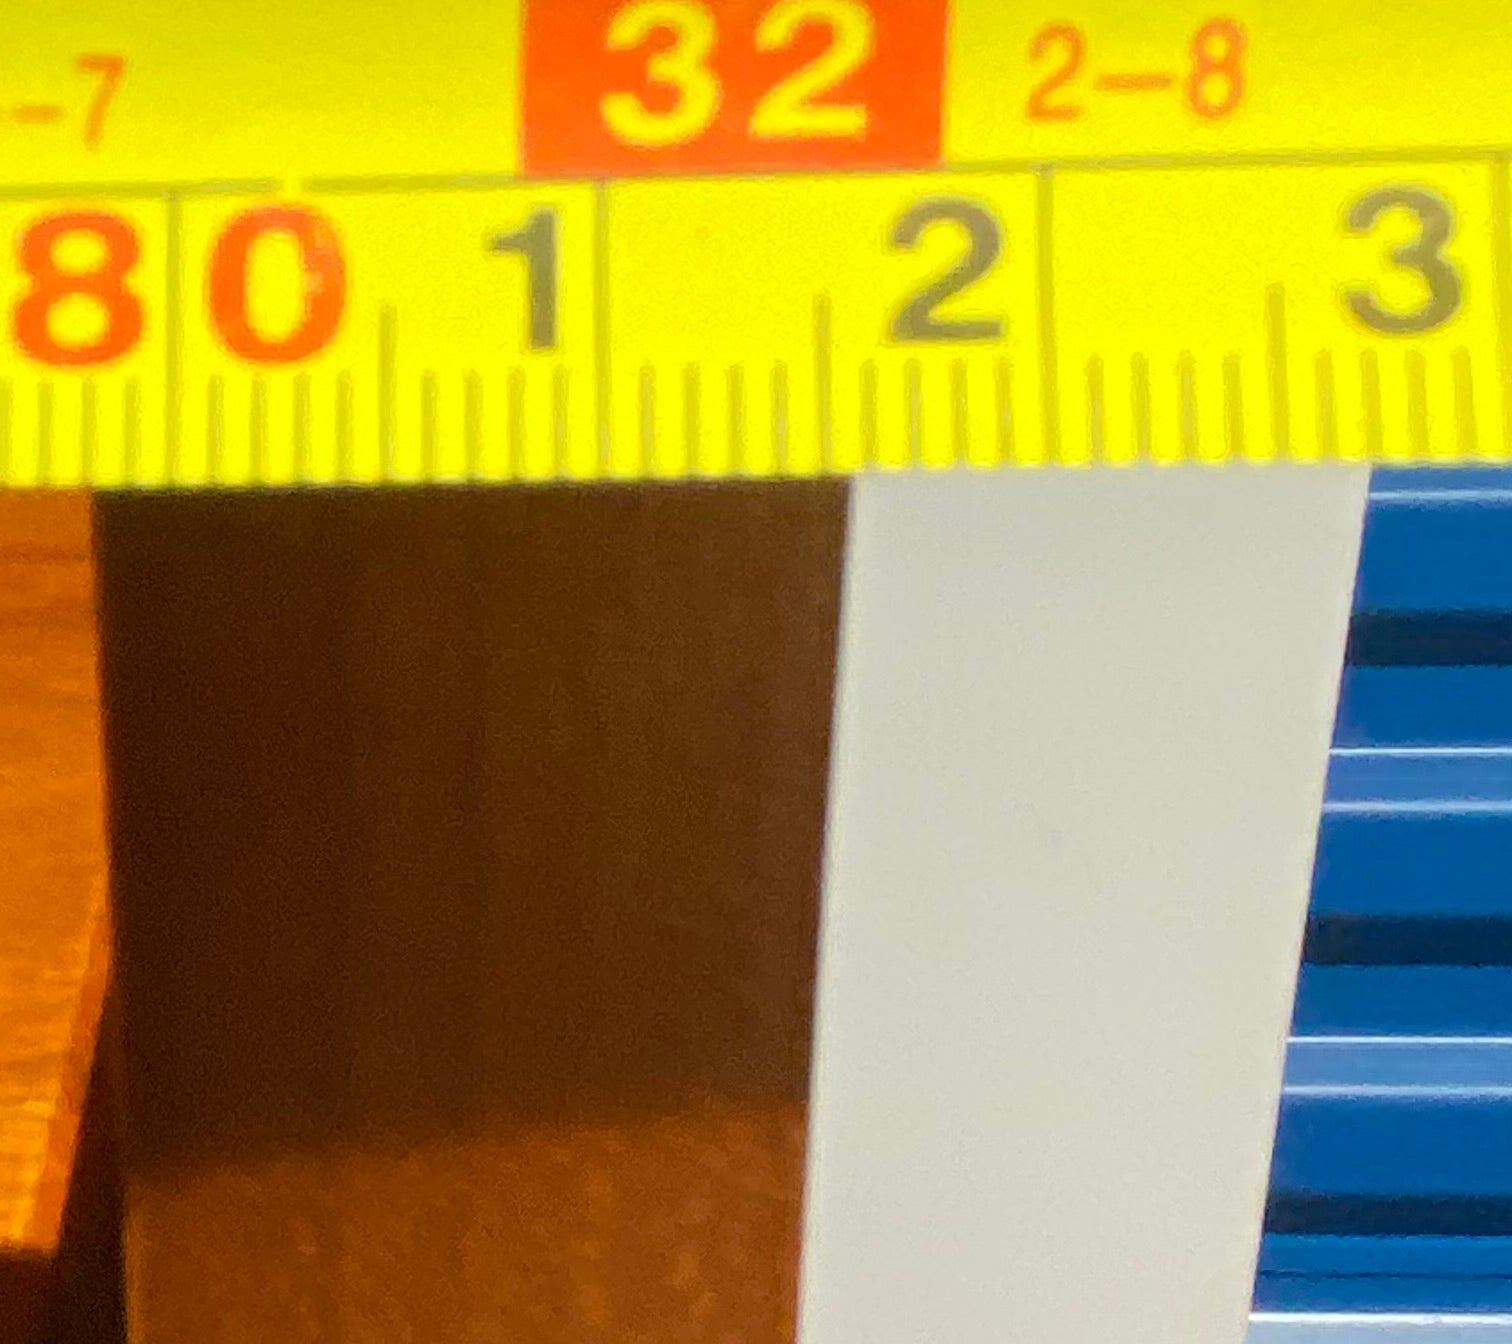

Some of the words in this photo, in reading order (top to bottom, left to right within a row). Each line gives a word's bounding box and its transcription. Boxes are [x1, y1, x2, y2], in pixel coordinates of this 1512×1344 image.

[489, 208, 557, 349] 1
[888, 196, 1004, 343] 2
[1340, 186, 1466, 338] 3
